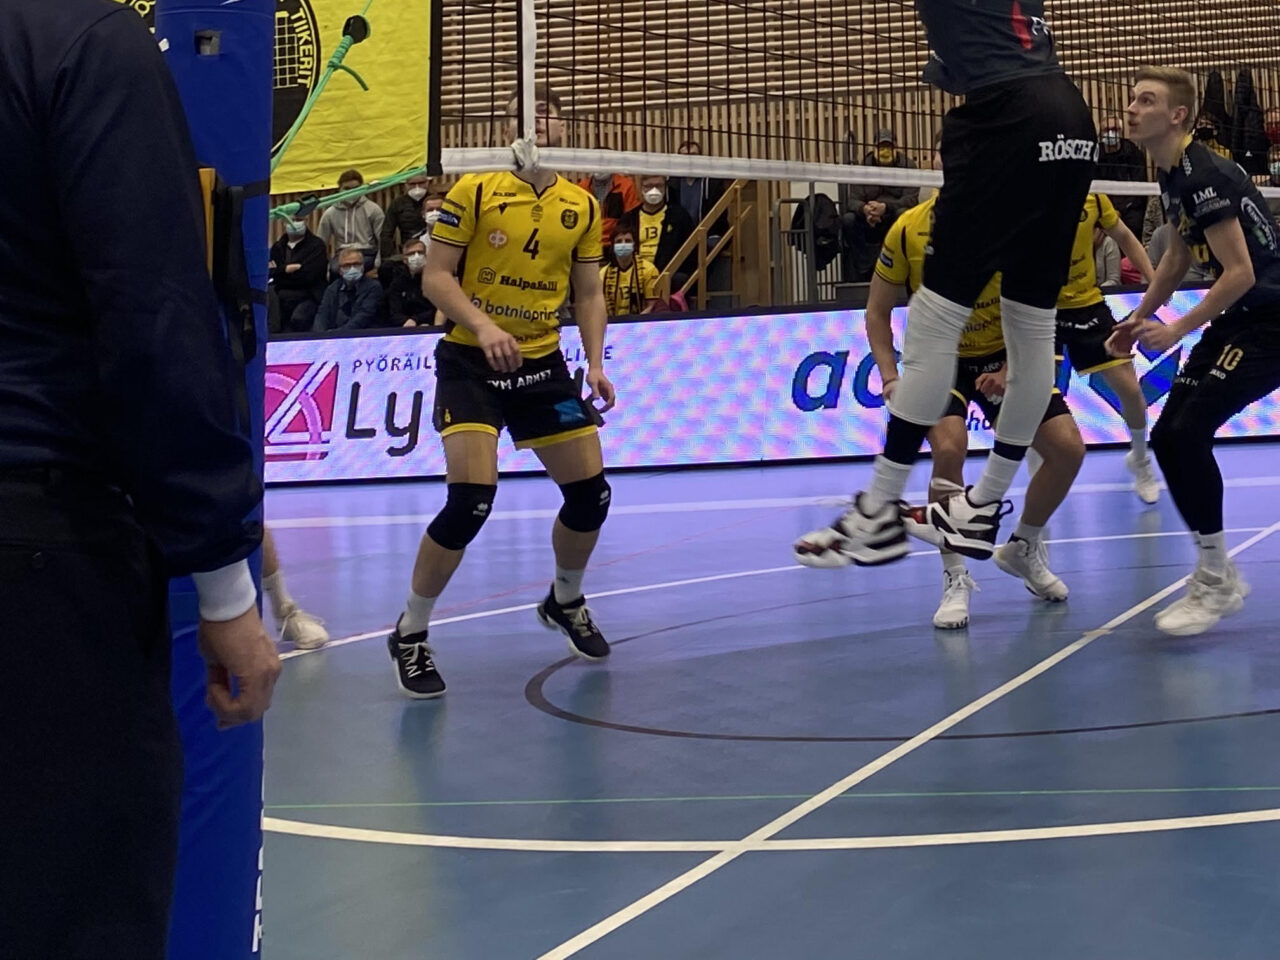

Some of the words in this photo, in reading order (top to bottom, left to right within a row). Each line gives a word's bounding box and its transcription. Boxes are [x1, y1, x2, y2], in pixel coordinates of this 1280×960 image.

[290, 7, 315, 88] TIIKERIT
[1038, 134, 1093, 162] RÖSCH
[523, 228, 539, 260] 4
[645, 227, 658, 239] 13
[353, 352, 432, 373] PYÖRÄIL
[1216, 344, 1244, 371] 10
